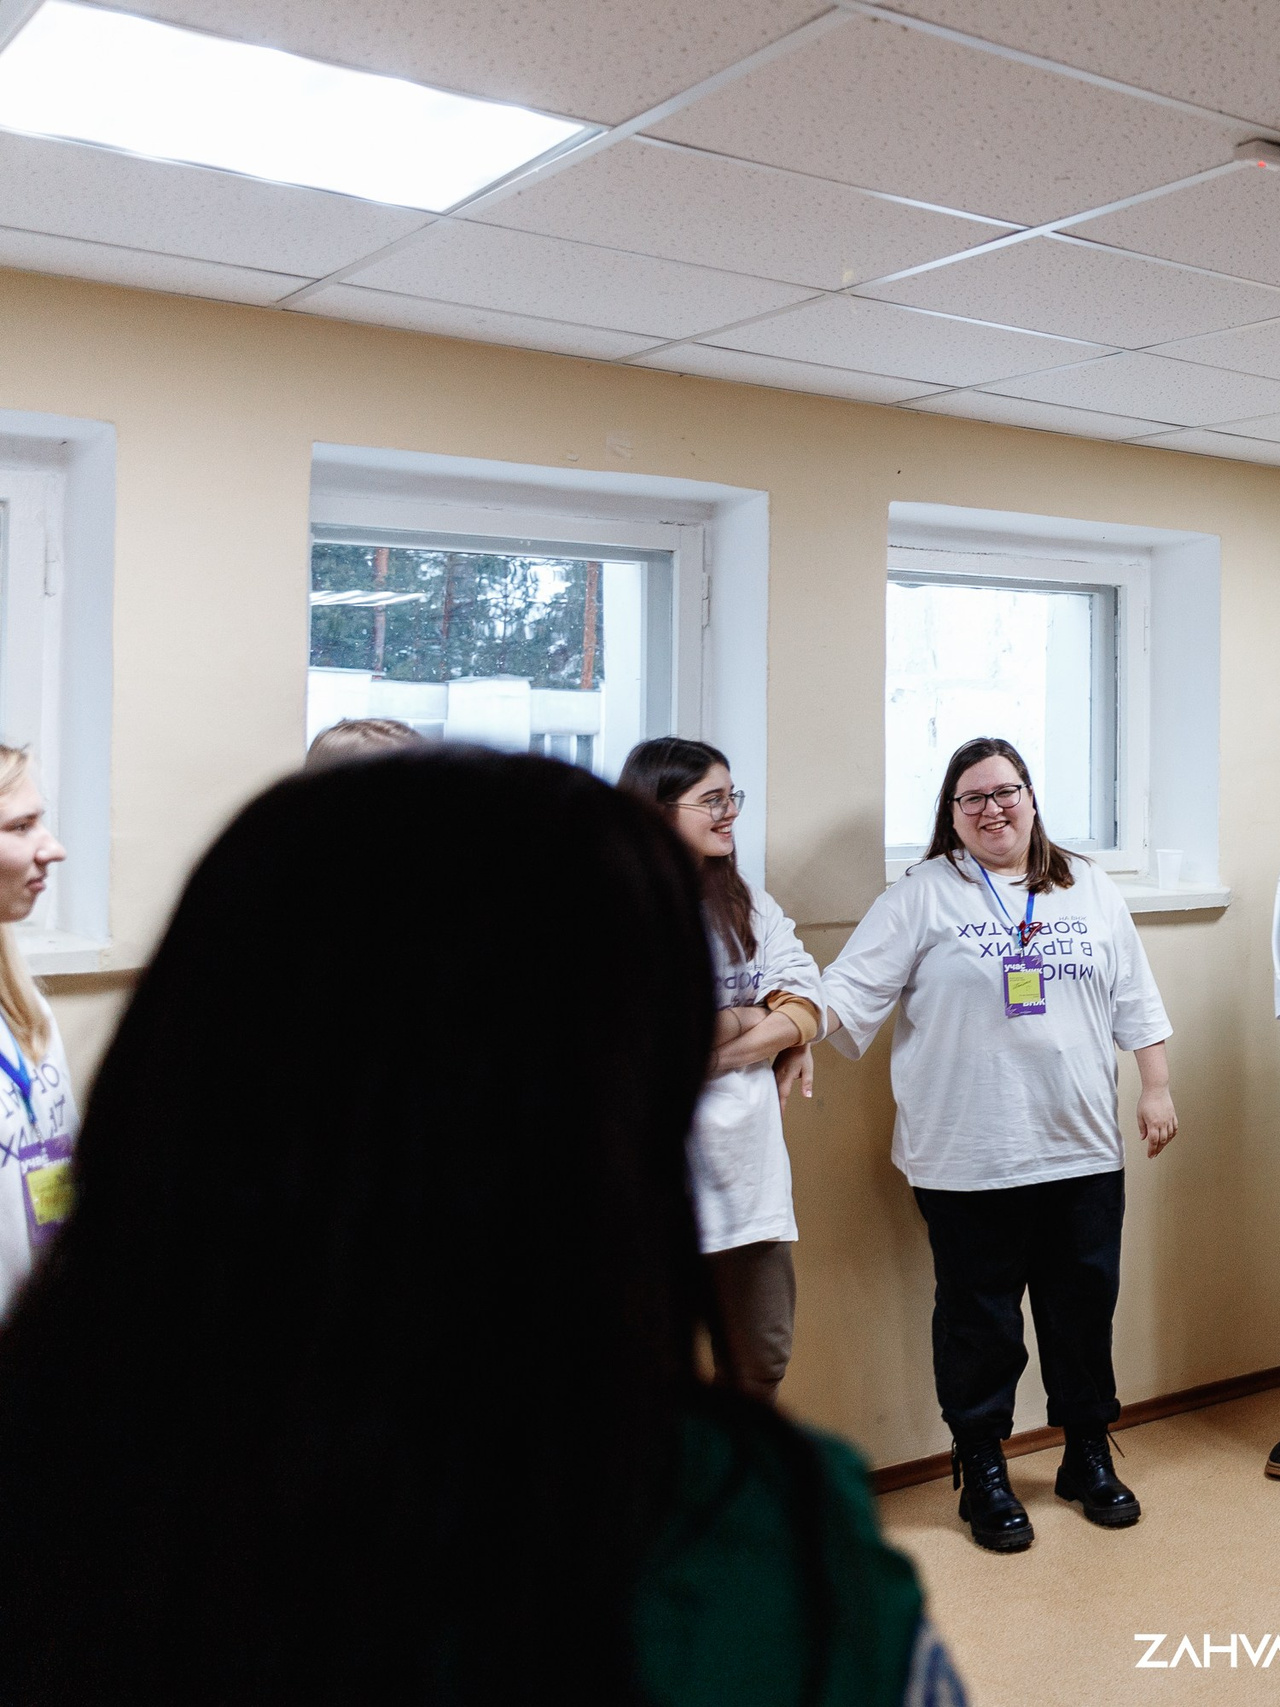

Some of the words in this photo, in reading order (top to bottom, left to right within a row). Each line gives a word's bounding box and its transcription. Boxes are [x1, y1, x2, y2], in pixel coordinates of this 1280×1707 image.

[956, 921, 1088, 938] ФОРАТАХ
[979, 938, 1073, 958] ДРУИХ
[1081, 941, 1093, 957] В
